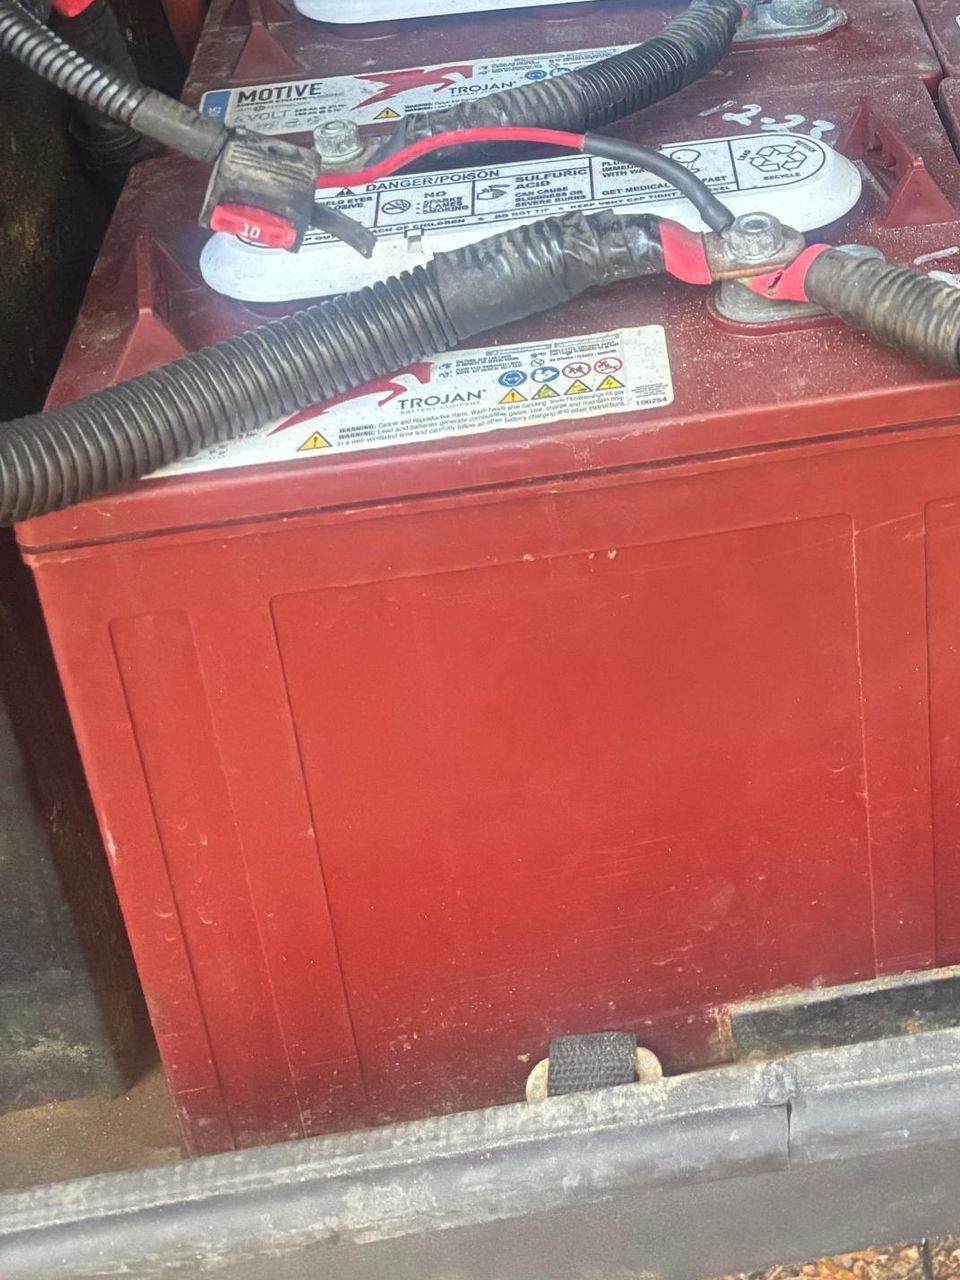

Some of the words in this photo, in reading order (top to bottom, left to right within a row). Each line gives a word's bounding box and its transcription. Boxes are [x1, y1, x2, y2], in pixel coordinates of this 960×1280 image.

[237, 82, 323, 104] MOTIVE
[449, 81, 514, 95] TROJAN
[246, 109, 291, 121] VOLT
[514, 169, 588, 183] SULFURIC
[602, 170, 629, 178] WITH
[763, 171, 801, 182] RECYCLE
[365, 169, 500, 192] DANGER/POISON
[514, 180, 551, 190] ACID
[602, 188, 623, 196] GET
[625, 182, 671, 193] MEDICAL
[702, 175, 727, 183] FAST
[423, 190, 447, 199] NO
[514, 190, 536, 198] CAN
[537, 186, 569, 196] CAUSE
[648, 191, 678, 200] TIGHT
[514, 199, 553, 208] SEVERE
[554, 194, 588, 204] BURNS
[422, 204, 470, 215] SMOKING
[240, 223, 262, 240] 10
[398, 389, 486, 411] TROJAN
[636, 396, 668, 406] 106254
[339, 423, 377, 434] WARNING:
[339, 429, 377, 440] WARNING:
